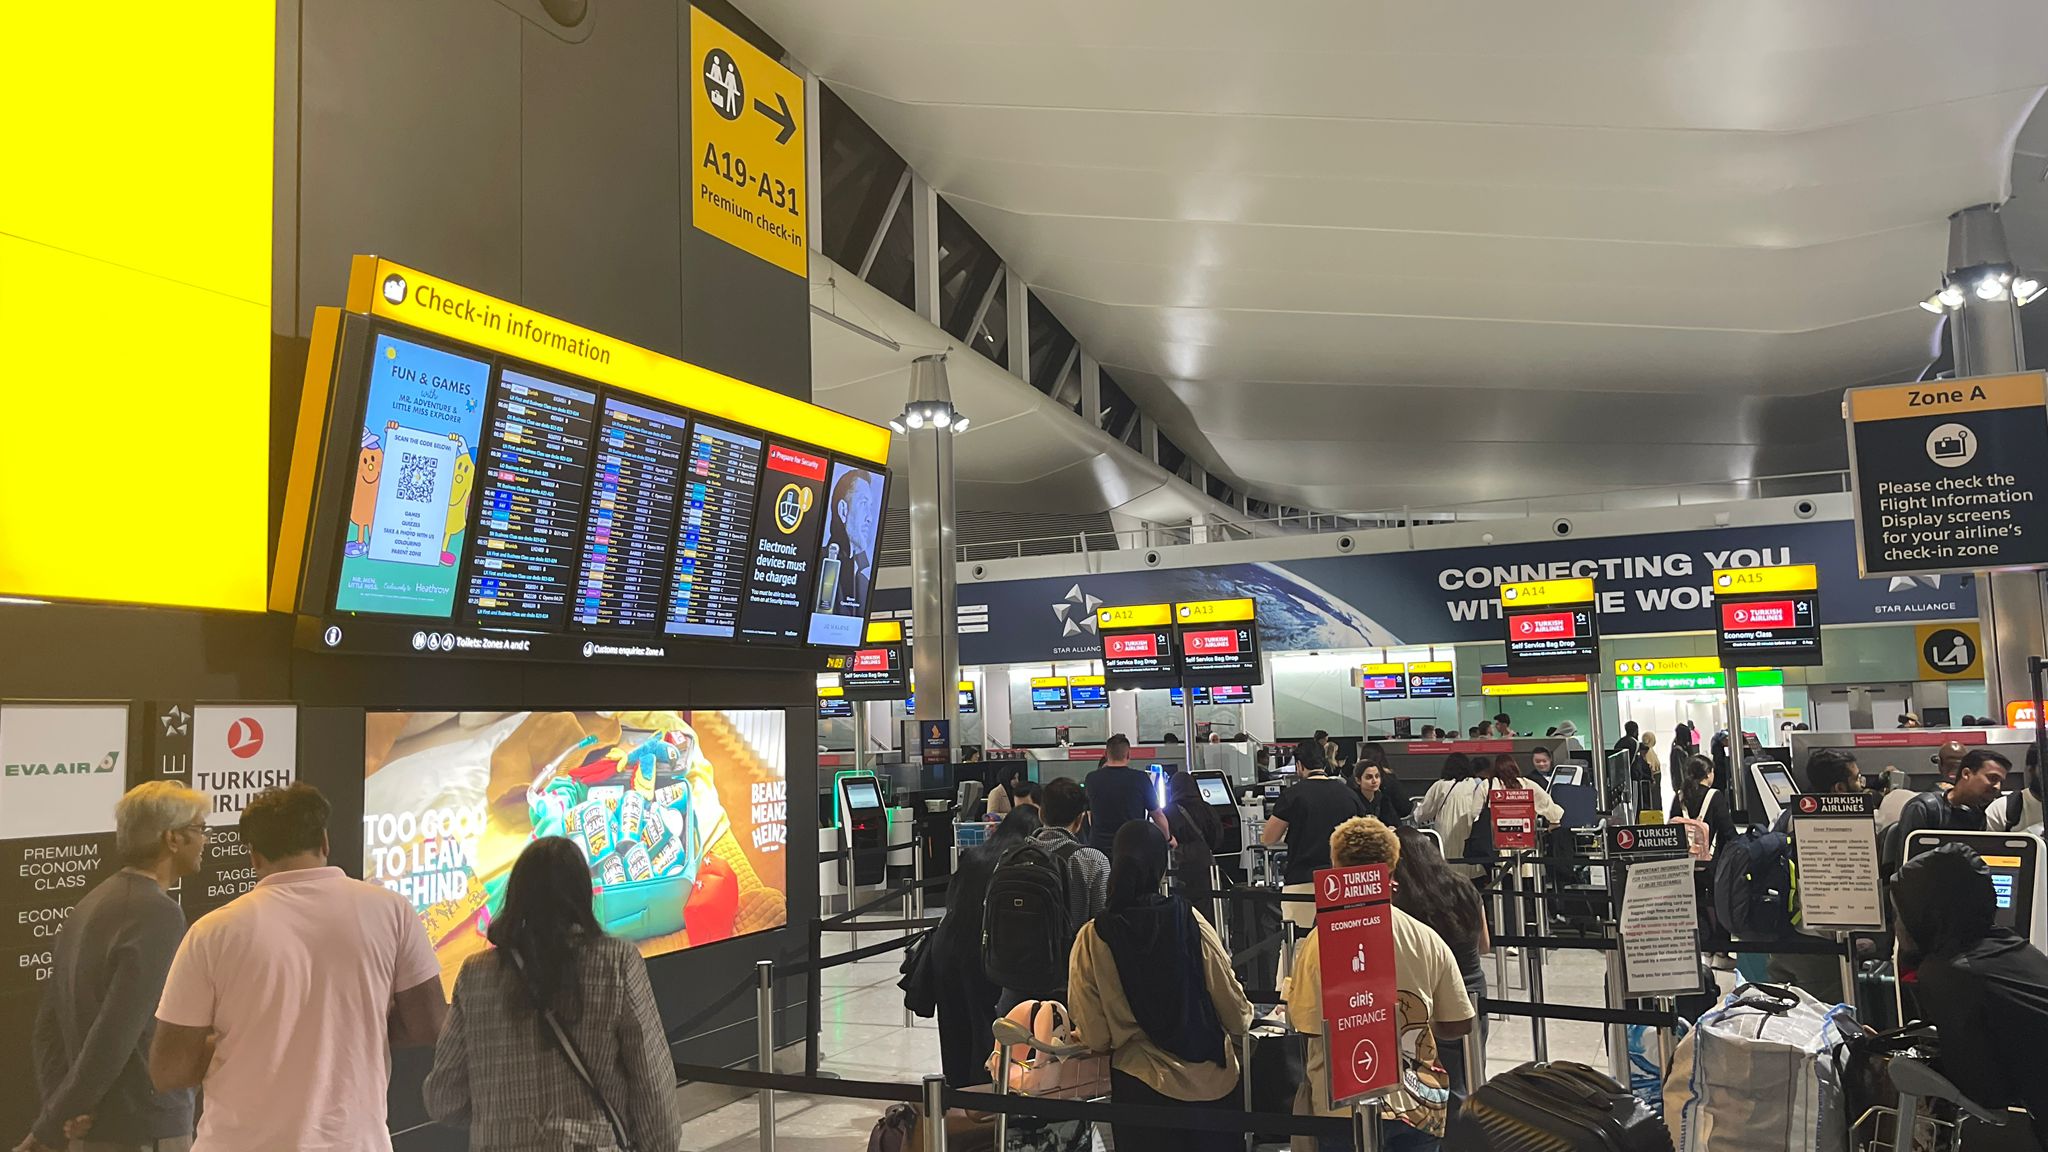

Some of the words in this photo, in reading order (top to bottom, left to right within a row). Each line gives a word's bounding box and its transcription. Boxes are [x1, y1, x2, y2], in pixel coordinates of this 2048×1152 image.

[703, 142, 799, 216] A19-A31
[701, 184, 753, 224] Premium
[756, 214, 802, 248] check-in
[415, 285, 501, 331] Check-in
[506, 313, 611, 365] information
[391, 365, 416, 382] FUN
[419, 373, 428, 386] &
[432, 376, 471, 395] GAMES
[1908, 389, 1963, 406] Zone
[1969, 385, 1987, 401] A
[392, 401, 411, 413] LITTLE
[412, 405, 429, 416] MISS
[430, 407, 462, 424] EXPLORER
[413, 396, 451, 413] ADVENTURE
[394, 434, 409, 443] SCAN
[410, 437, 419, 445] THE
[420, 439, 433, 448] CODE
[776, 451, 794, 462] Prepare
[801, 458, 819, 470] Security
[1879, 480, 1932, 495] Please
[1935, 473, 1983, 490] check
[1986, 473, 2015, 487] the
[1880, 496, 1927, 514] Flight
[1931, 489, 2033, 508] Information
[1881, 513, 1943, 529] Display
[1947, 507, 2011, 523] screens
[1882, 531, 1908, 544] for
[1911, 528, 1950, 545] your
[1955, 523, 2023, 540] airline's
[759, 538, 797, 555] Electronic
[1884, 544, 1953, 561] check-in
[1957, 543, 1999, 556] zone
[756, 553, 786, 569] devices
[786, 560, 806, 572] must
[1438, 553, 1693, 591] CONNECTING
[1703, 547, 1790, 569] YOU
[754, 568, 765, 581] be
[765, 570, 798, 587] charged
[1737, 573, 1763, 583] A15
[416, 583, 450, 594] Heathrow
[1521, 586, 1546, 597] A14
[1194, 606, 1214, 615] A13
[1447, 599, 1503, 622] WIT
[1636, 586, 1715, 611] WOR
[1875, 605, 1902, 614] STAR
[1904, 602, 1956, 612] ALLIANCE
[1114, 610, 1134, 619] A12
[1749, 614, 1783, 622] AIRLINES
[1534, 625, 1565, 633] AIRLINES
[1724, 632, 1754, 640] Economy
[456, 636, 482, 648] Toilets:
[482, 638, 504, 649] Zones
[503, 640, 510, 649] A
[510, 640, 524, 650] and
[524, 640, 531, 651] C
[594, 644, 619, 654] Customs
[645, 647, 659, 656] Zone
[658, 648, 665, 657] A
[1072, 645, 1102, 653] ALLIANC
[1511, 642, 1524, 650] Self
[1524, 641, 1546, 649] Service
[1546, 641, 1559, 649] Bag
[1559, 640, 1576, 648] Drop
[1144, 658, 1158, 666] Drop
[1658, 661, 1688, 670] Toilets
[1645, 676, 1695, 688] Emergency
[1697, 675, 1716, 686] exit
[2015, 708, 2036, 719] AT
[5, 764, 51, 777] EVA
[53, 762, 91, 775] AIR
[197, 769, 291, 791] TURKISH
[751, 780, 787, 804] BEANZ
[1821, 797, 1863, 805] TURKISH
[1821, 804, 1864, 812] AIRLINES
[751, 800, 787, 825] MEANZ
[363, 811, 417, 846] TOO
[421, 804, 488, 839] GOOD
[1636, 828, 1677, 838] TURKISH
[751, 823, 787, 849] HEINZ
[1637, 836, 1678, 848] AIRLINES
[24, 843, 98, 861] PREMIUM
[19, 858, 102, 877] ECONOMY
[372, 846, 407, 879] TO
[34, 874, 86, 891] CLASS
[216, 867, 257, 882] TAGGE
[1343, 870, 1381, 886] TURKISH
[207, 883, 235, 897] BAG
[1343, 883, 1382, 899] AIRLINES
[33, 923, 63, 938] CLA
[1331, 919, 1361, 931] ECONOMY
[1362, 916, 1381, 926] CLASS
[1338, 1008, 1387, 1031] ENTRANCE
